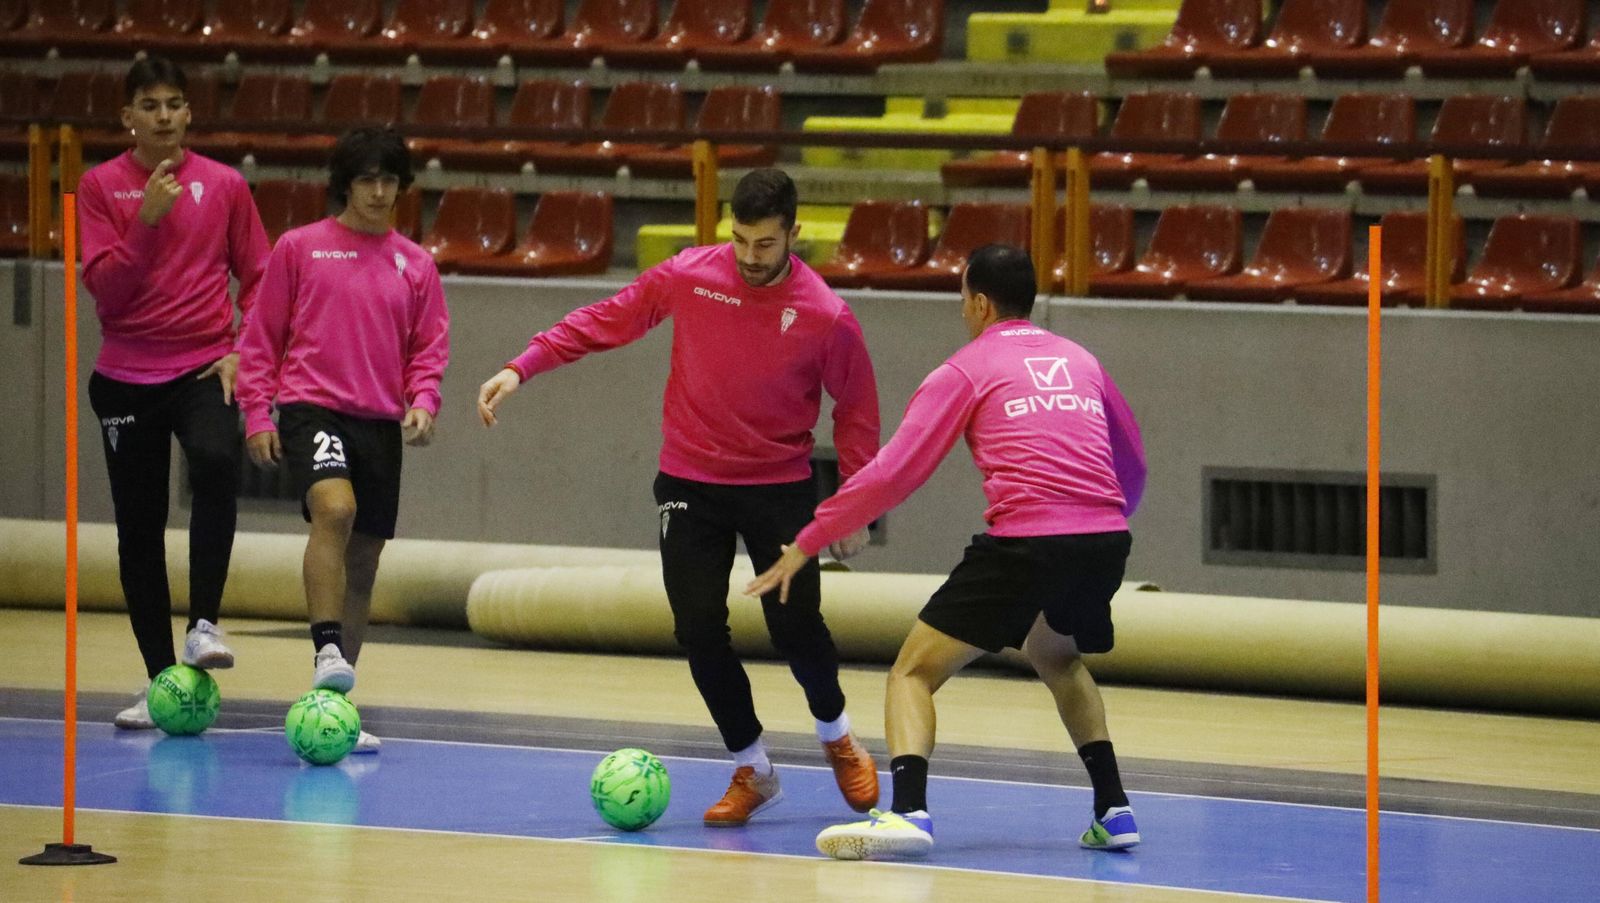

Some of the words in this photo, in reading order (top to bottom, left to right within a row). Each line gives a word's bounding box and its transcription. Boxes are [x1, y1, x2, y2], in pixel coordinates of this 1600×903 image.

[114, 190, 145, 199] GIVO
[312, 250, 358, 259] GIVOVA
[693, 286, 742, 307] GIVOVA
[1003, 394, 1105, 418] GIVOVA
[313, 430, 346, 462] 23
